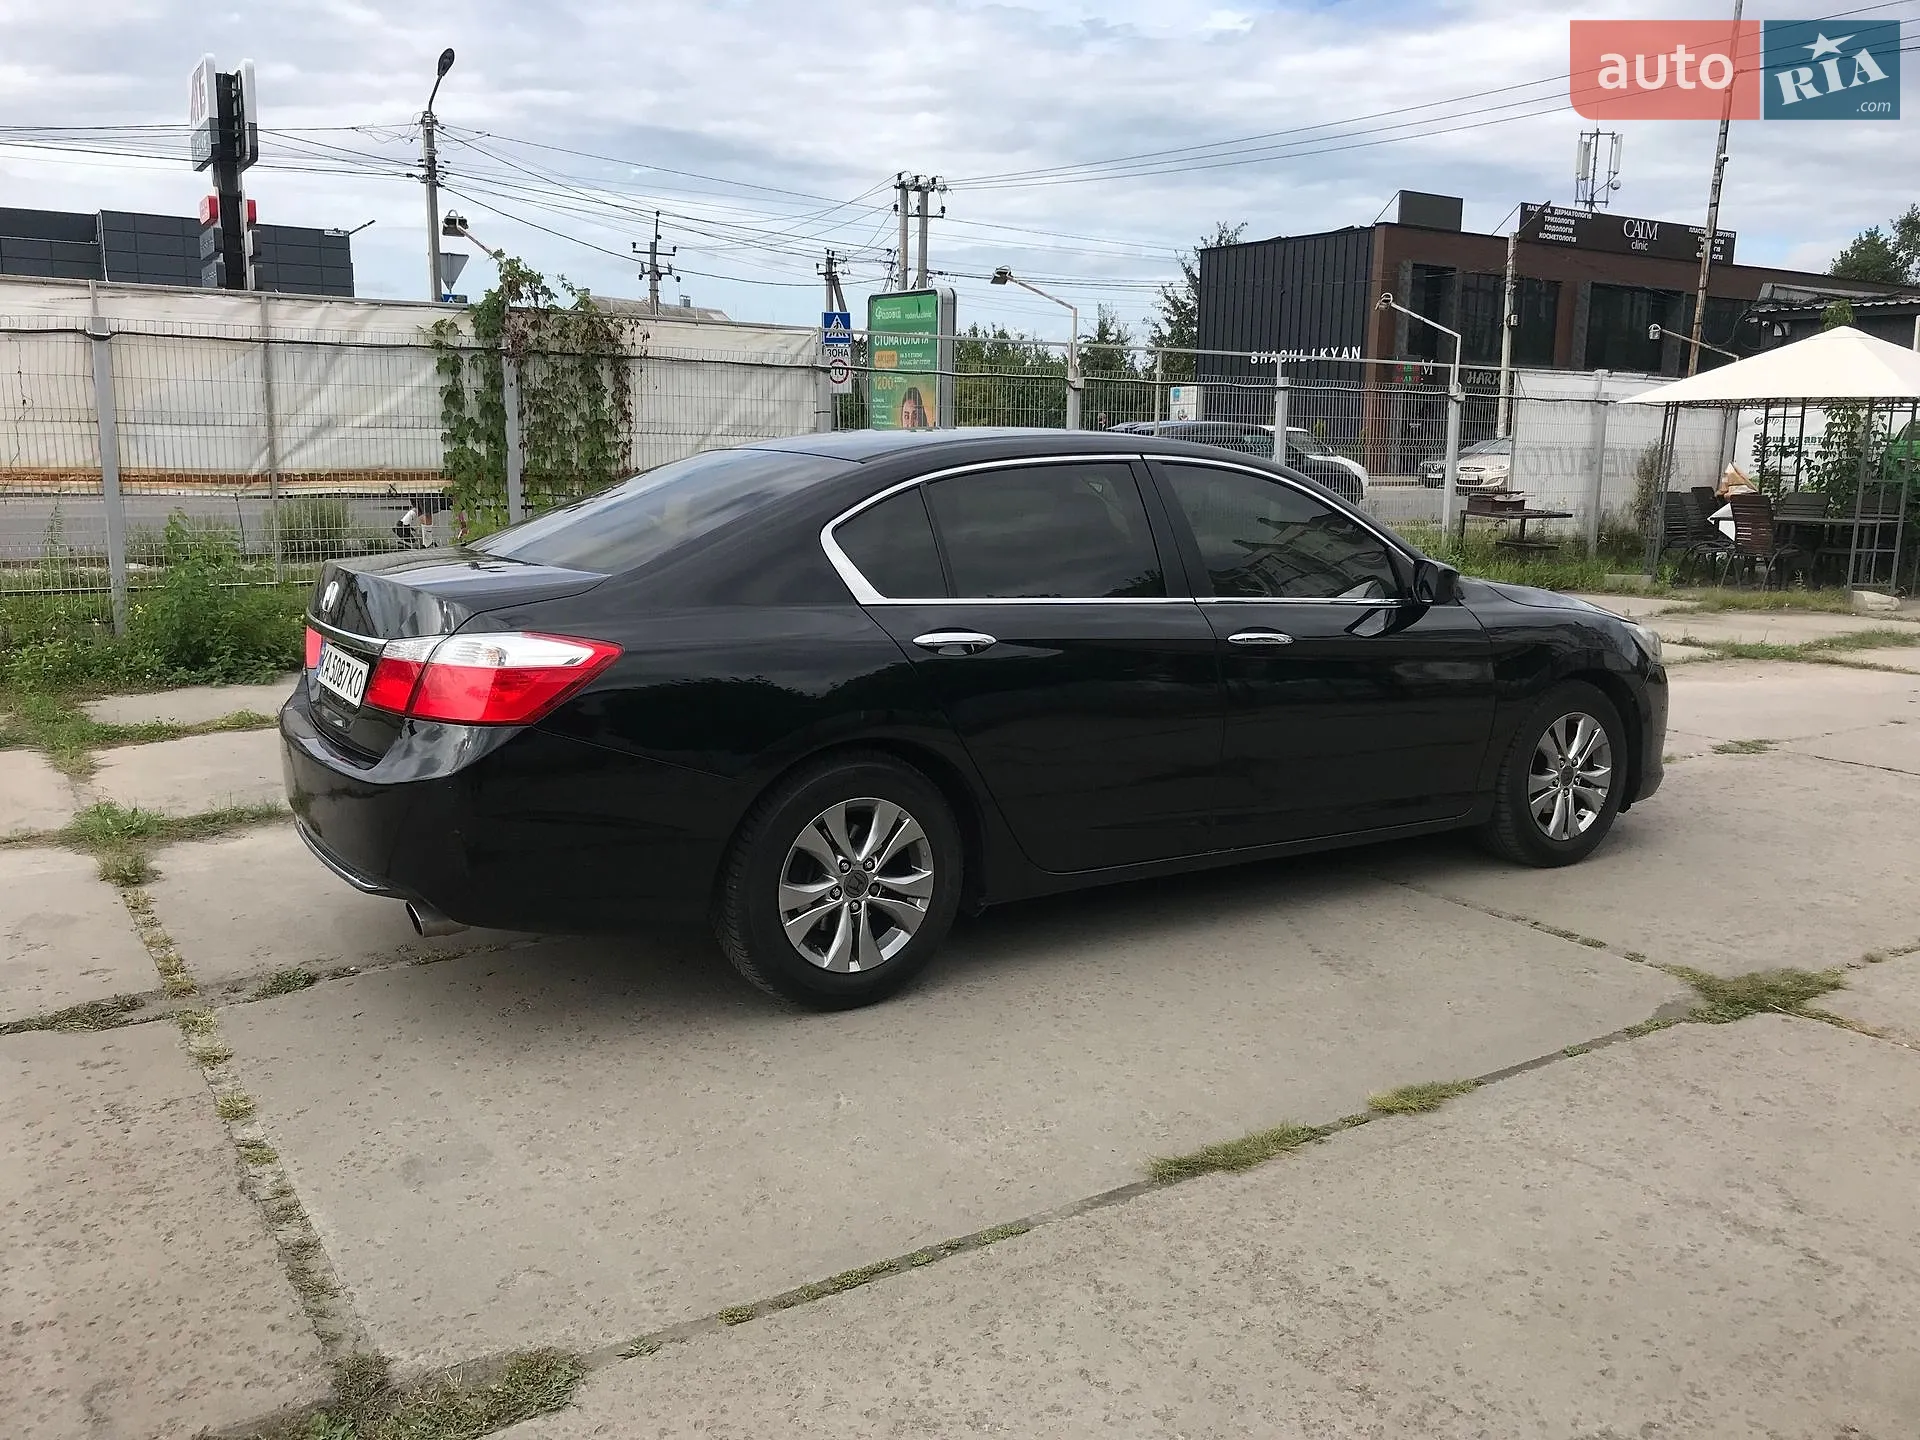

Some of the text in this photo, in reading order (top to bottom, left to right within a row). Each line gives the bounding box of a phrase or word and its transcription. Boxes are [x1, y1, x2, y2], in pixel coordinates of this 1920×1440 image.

[1623, 219, 1660, 241] CALM
[1631, 241, 1649, 251] clinic
[827, 348, 849, 357] ЗОНА
